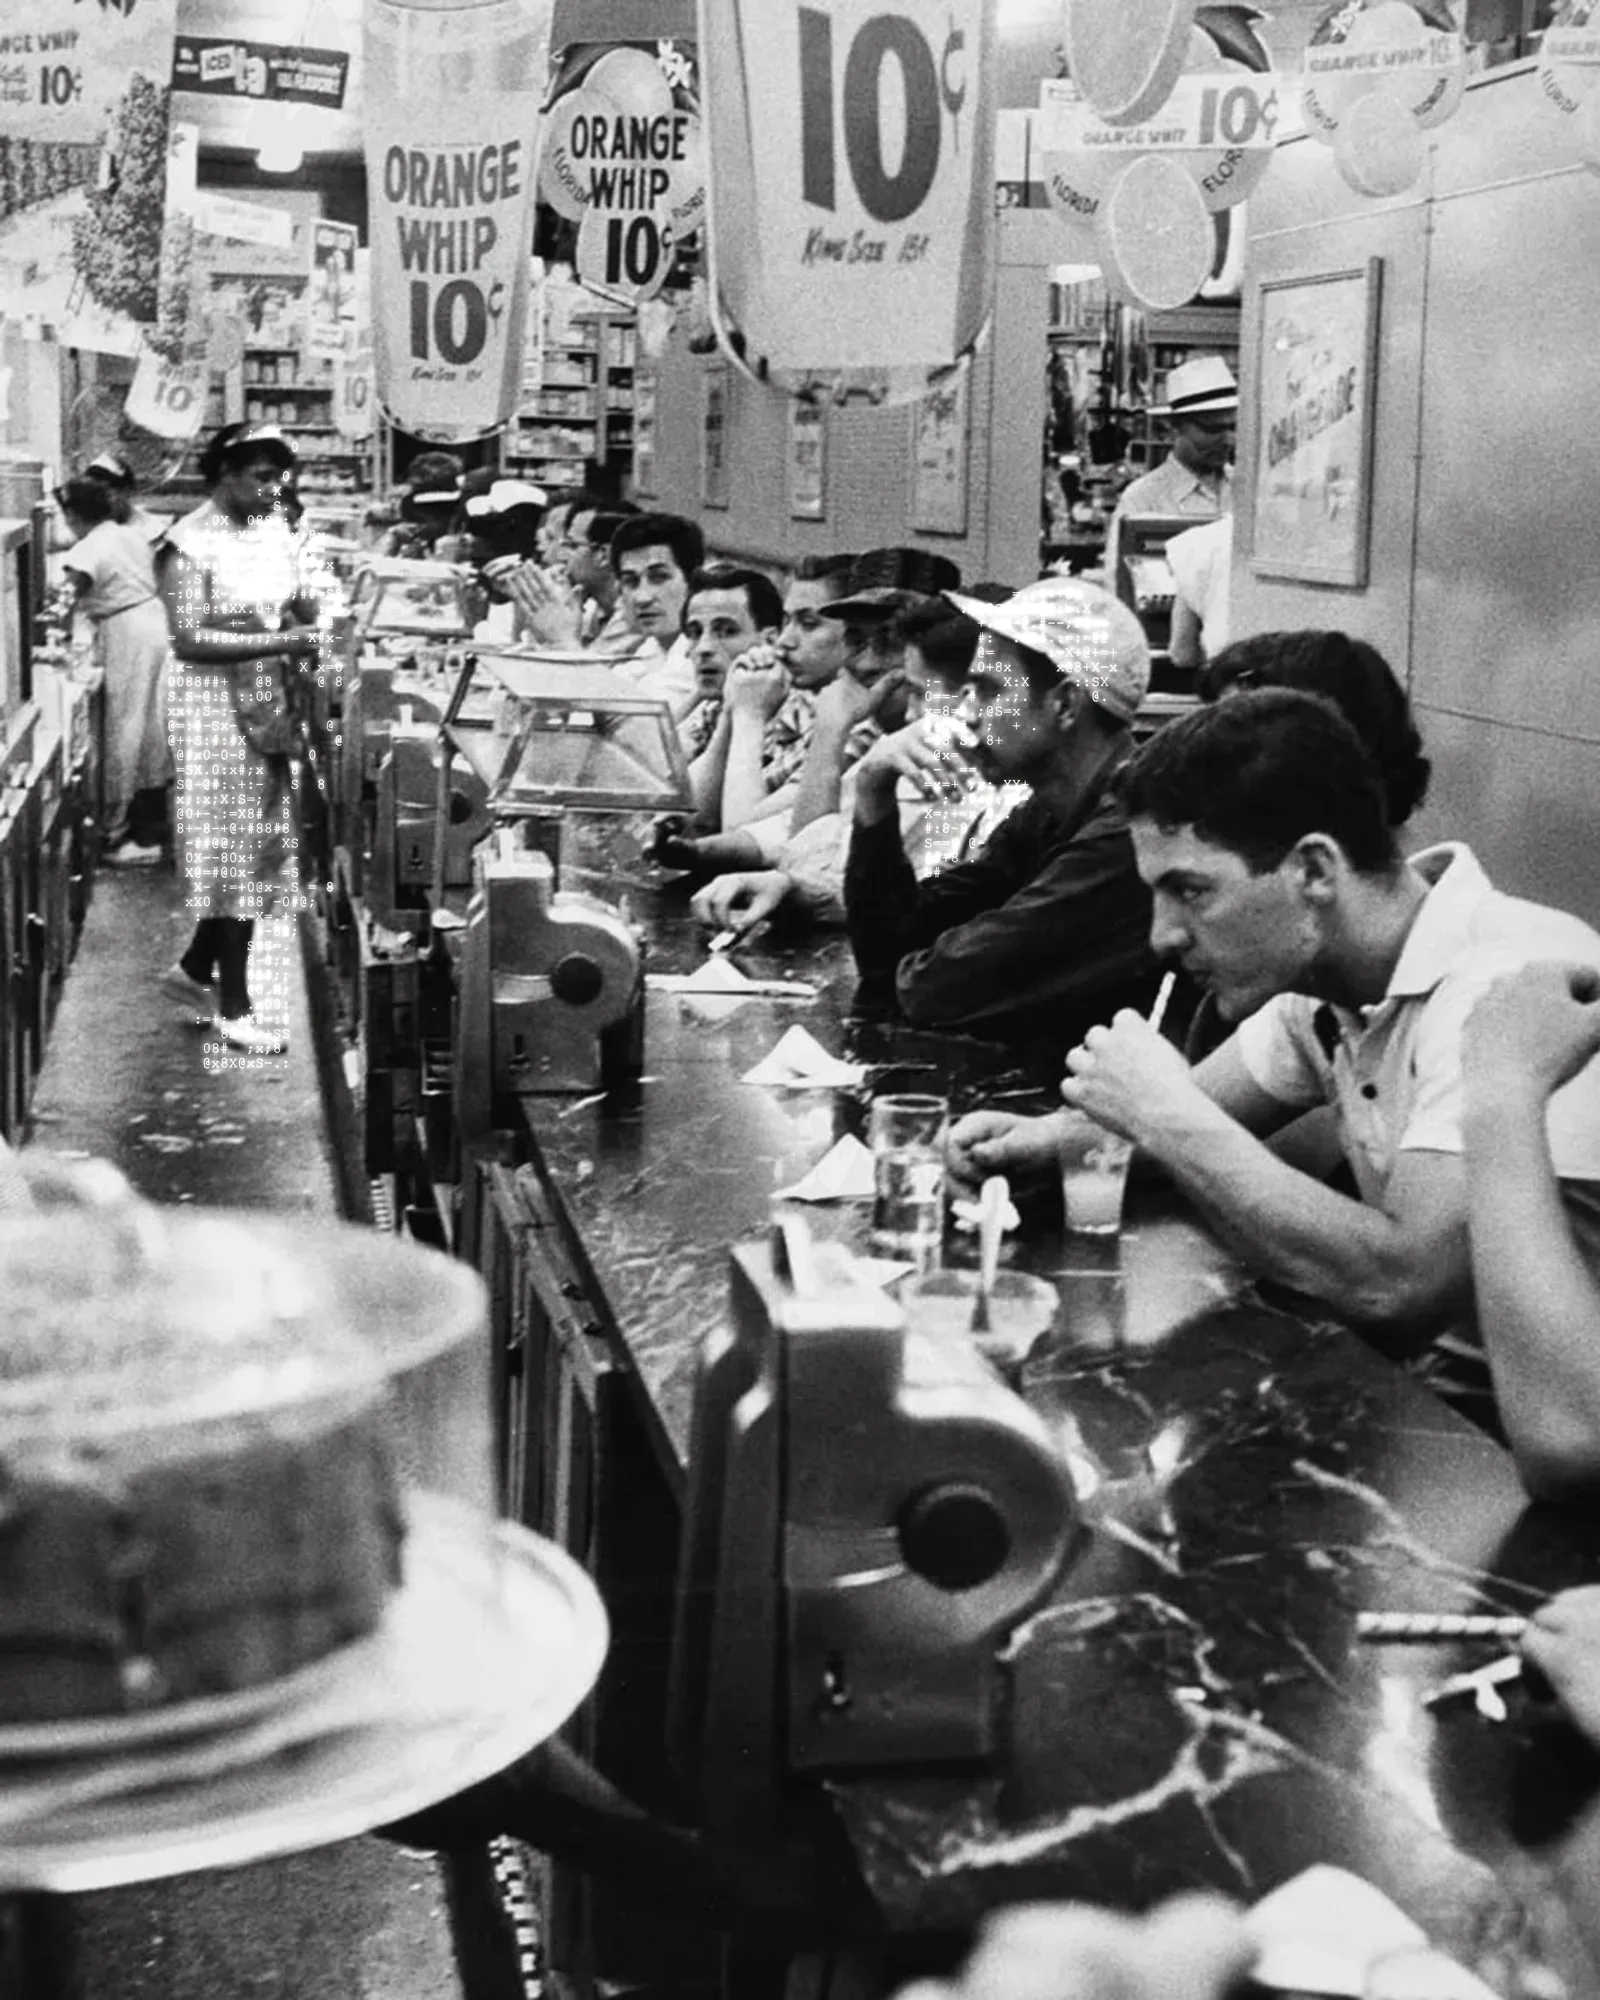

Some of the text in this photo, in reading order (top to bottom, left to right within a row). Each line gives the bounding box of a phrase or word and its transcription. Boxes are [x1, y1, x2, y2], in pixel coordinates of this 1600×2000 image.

[40, 64, 83, 105] 10¢
[799, 4, 967, 223] 10¢
[571, 114, 689, 161] ORANGE
[1199, 85, 1279, 144] 10¢
[384, 139, 522, 208] ORANGE
[590, 166, 670, 211] WHIP
[1201, 149, 1244, 193] FLOR
[396, 216, 498, 274] WHIP
[605, 215, 673, 286] 10¢
[409, 277, 504, 366] 10¢
